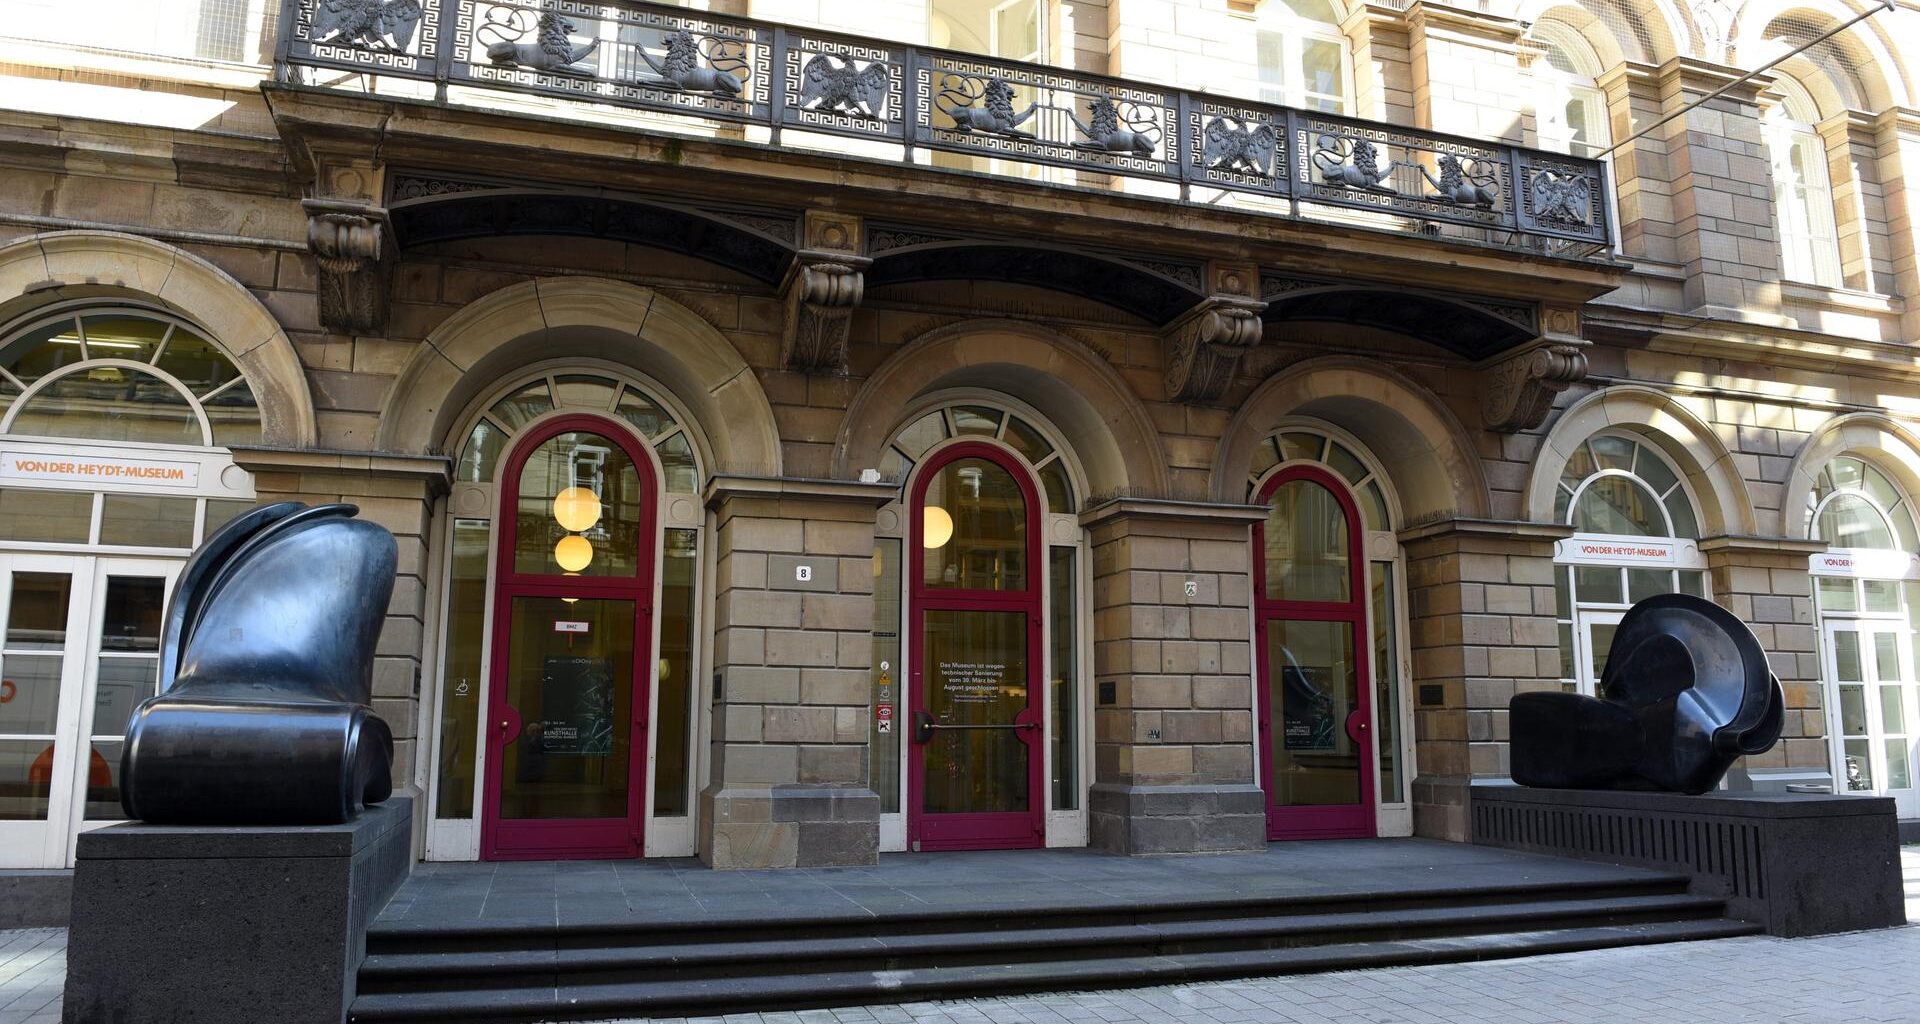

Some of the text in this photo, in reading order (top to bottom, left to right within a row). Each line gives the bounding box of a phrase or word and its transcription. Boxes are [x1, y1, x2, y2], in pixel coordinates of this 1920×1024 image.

[15, 460, 184, 480] VON DER HEYDT-MUSEUM
[1582, 545, 1667, 557] VON DER HEYDT-MUSEUM
[1824, 558, 1838, 566] VON
[1838, 559, 1850, 567] DER
[801, 569, 807, 578] 8
